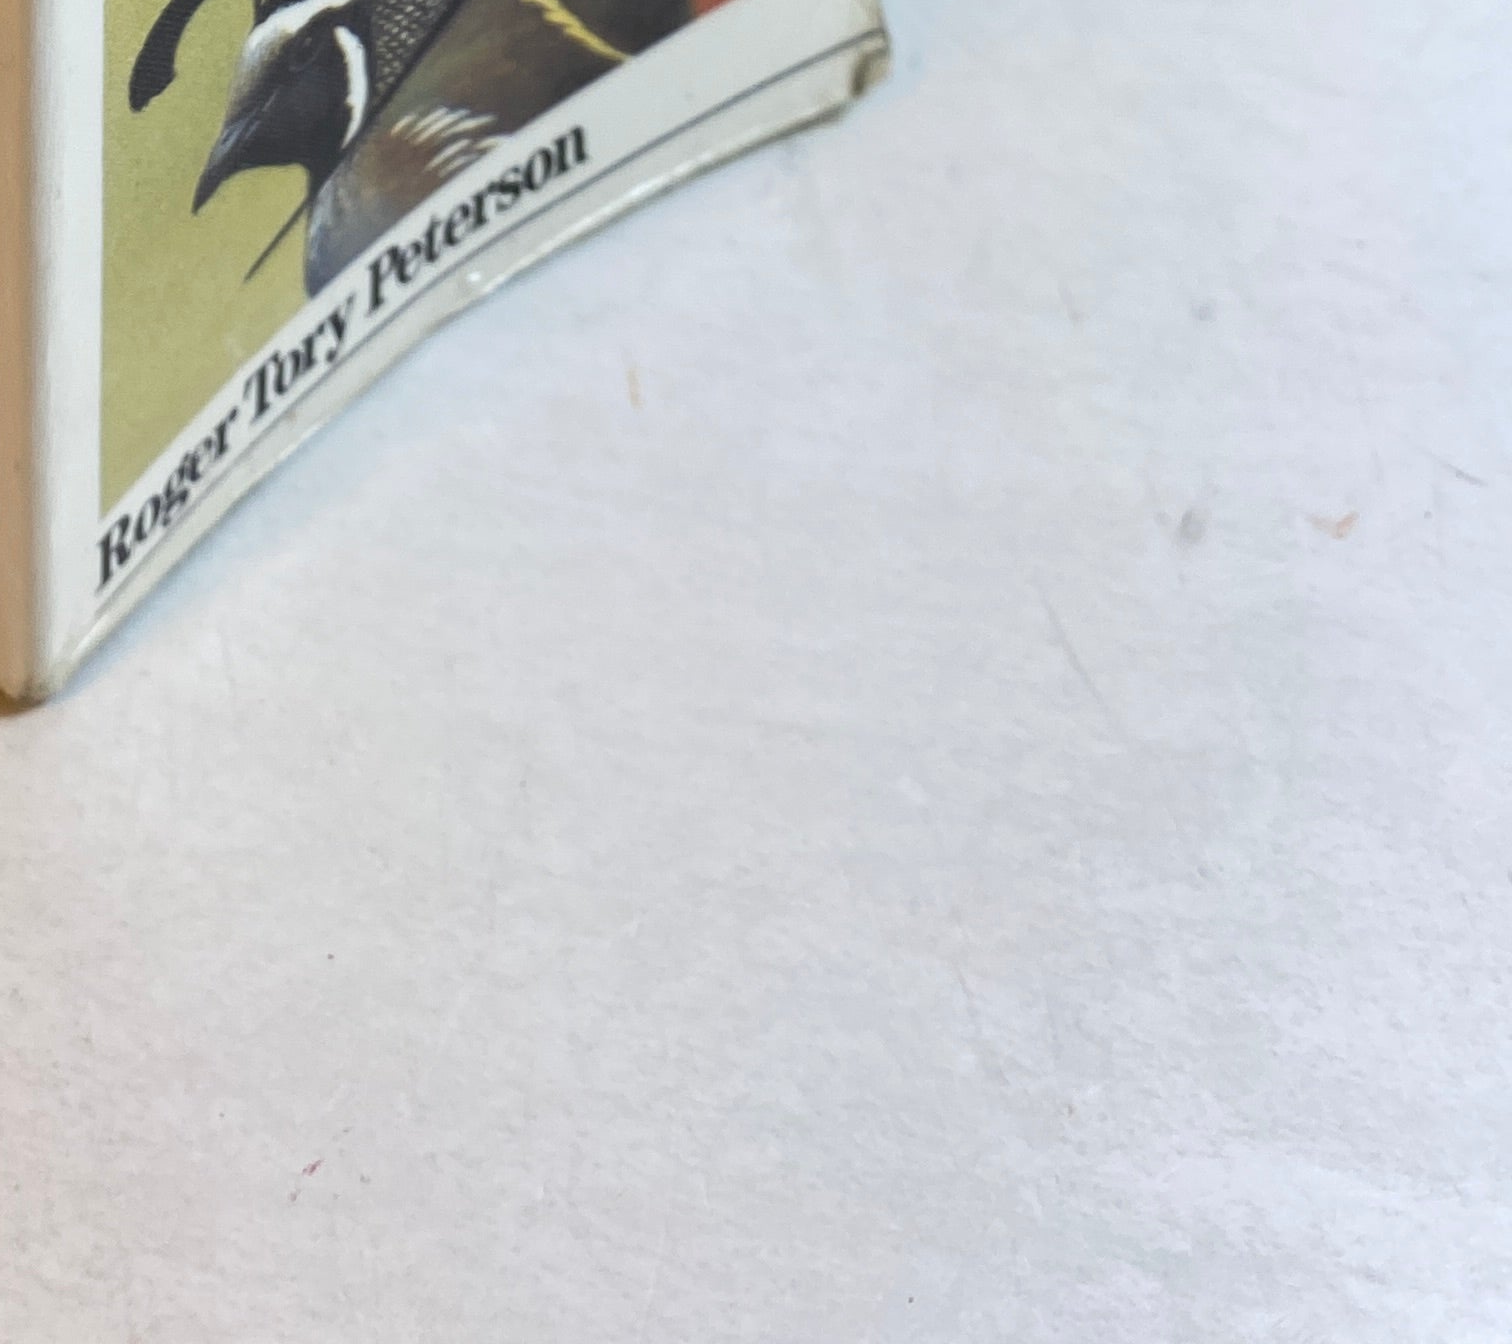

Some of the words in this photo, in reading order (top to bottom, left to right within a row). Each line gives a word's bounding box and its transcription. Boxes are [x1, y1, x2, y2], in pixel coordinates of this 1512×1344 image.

[95, 406, 241, 592] Roger
[241, 294, 359, 425] Tory
[362, 125, 592, 311] Peterson
